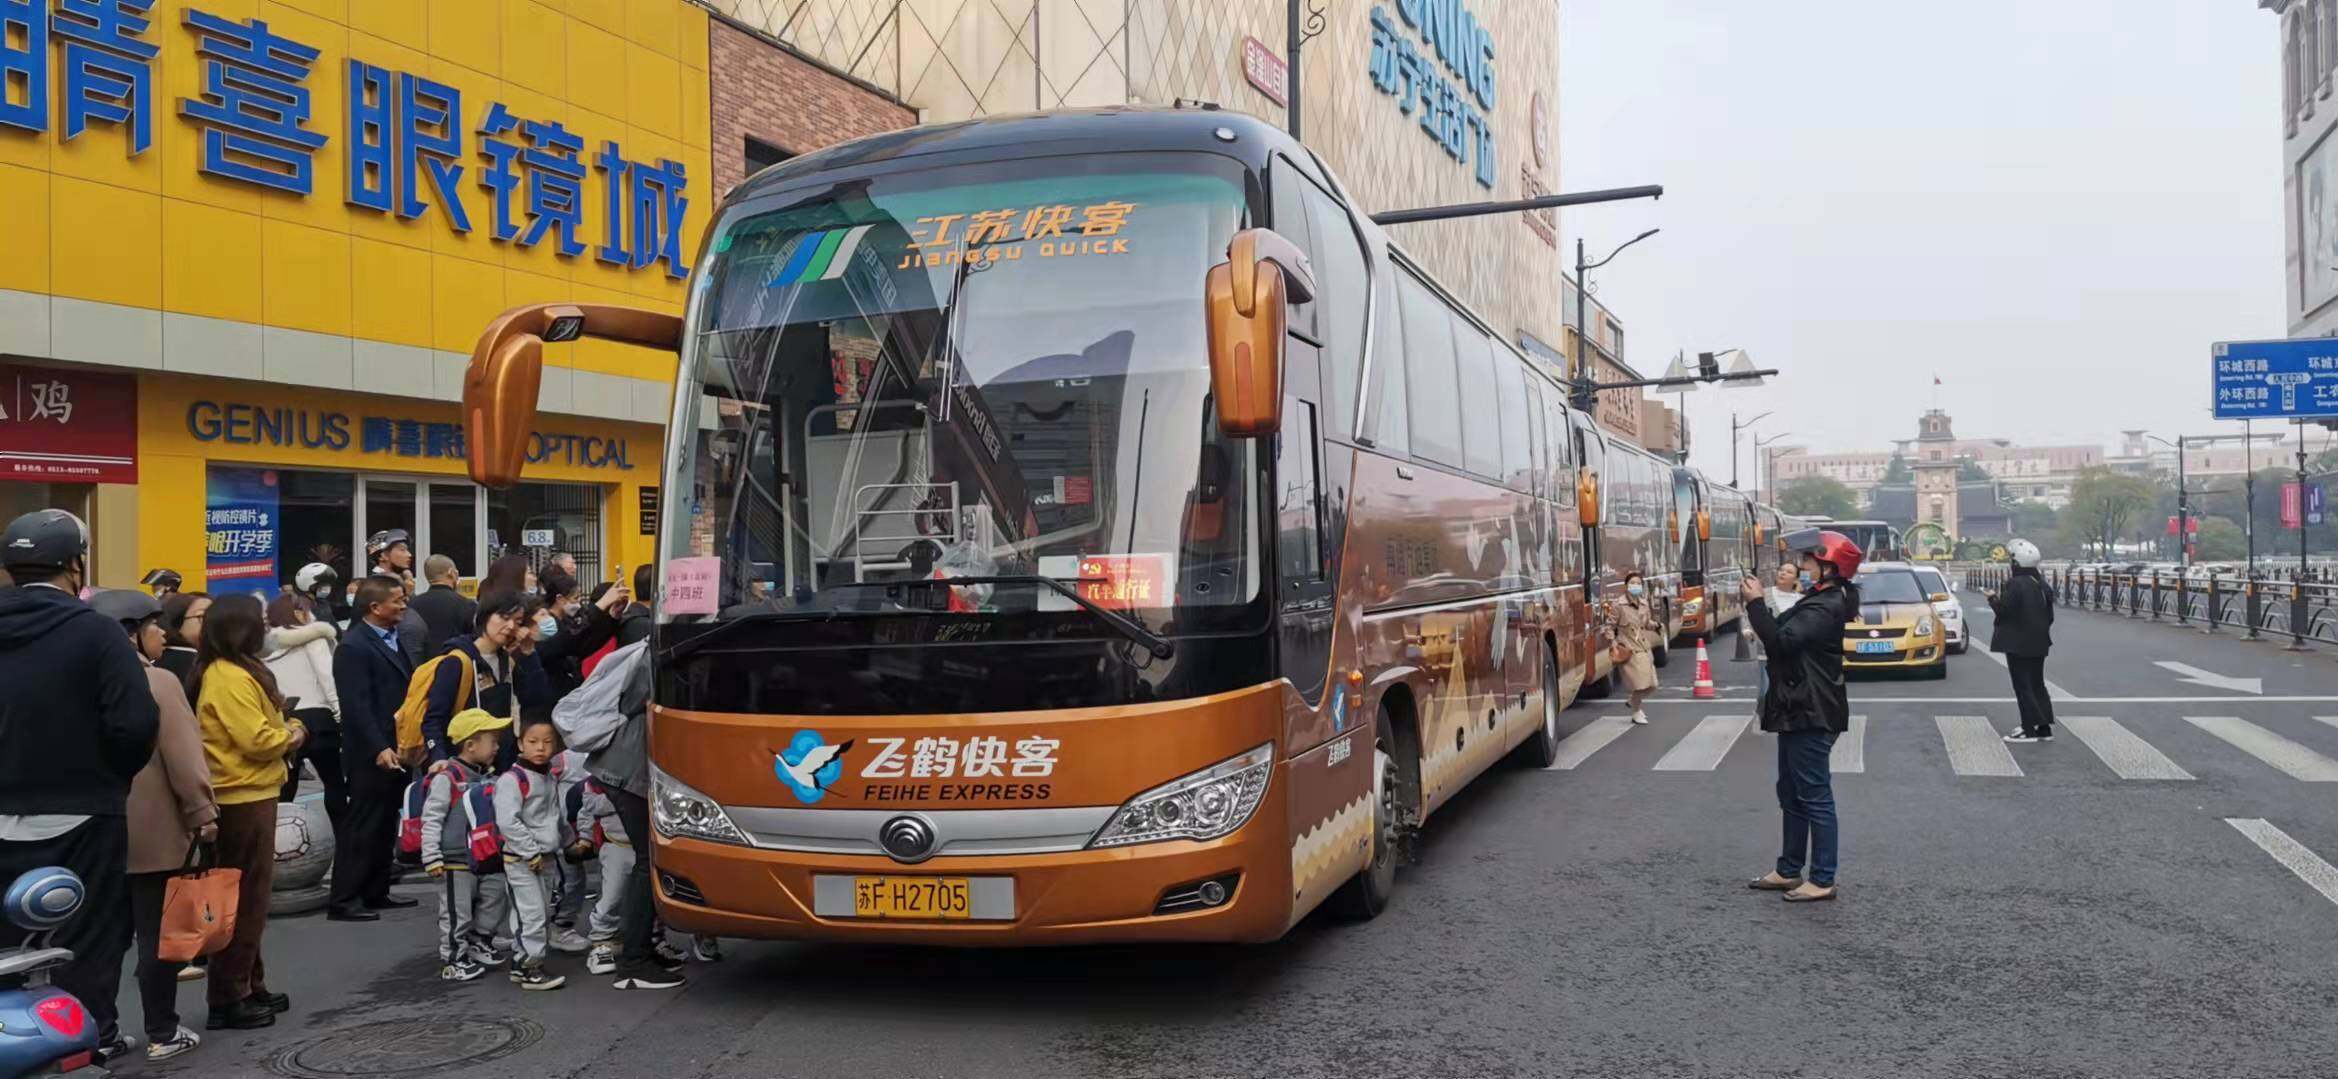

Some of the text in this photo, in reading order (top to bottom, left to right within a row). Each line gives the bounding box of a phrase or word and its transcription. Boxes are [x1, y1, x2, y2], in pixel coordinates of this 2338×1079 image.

[907, 201, 1138, 249] 江苏快客
[1040, 238, 1132, 257] QUICK
[2219, 359, 2268, 373] 环城西路
[28, 380, 73, 424] 鸡
[2219, 387, 2269, 401] 外环西路
[187, 401, 350, 451] GENIUS
[526, 431, 635, 470] OPTICAL
[206, 530, 273, 554] 眼开学季
[860, 735, 1060, 779] 飞鹤快客
[864, 783, 1051, 801] FEIHE EXPRESS
